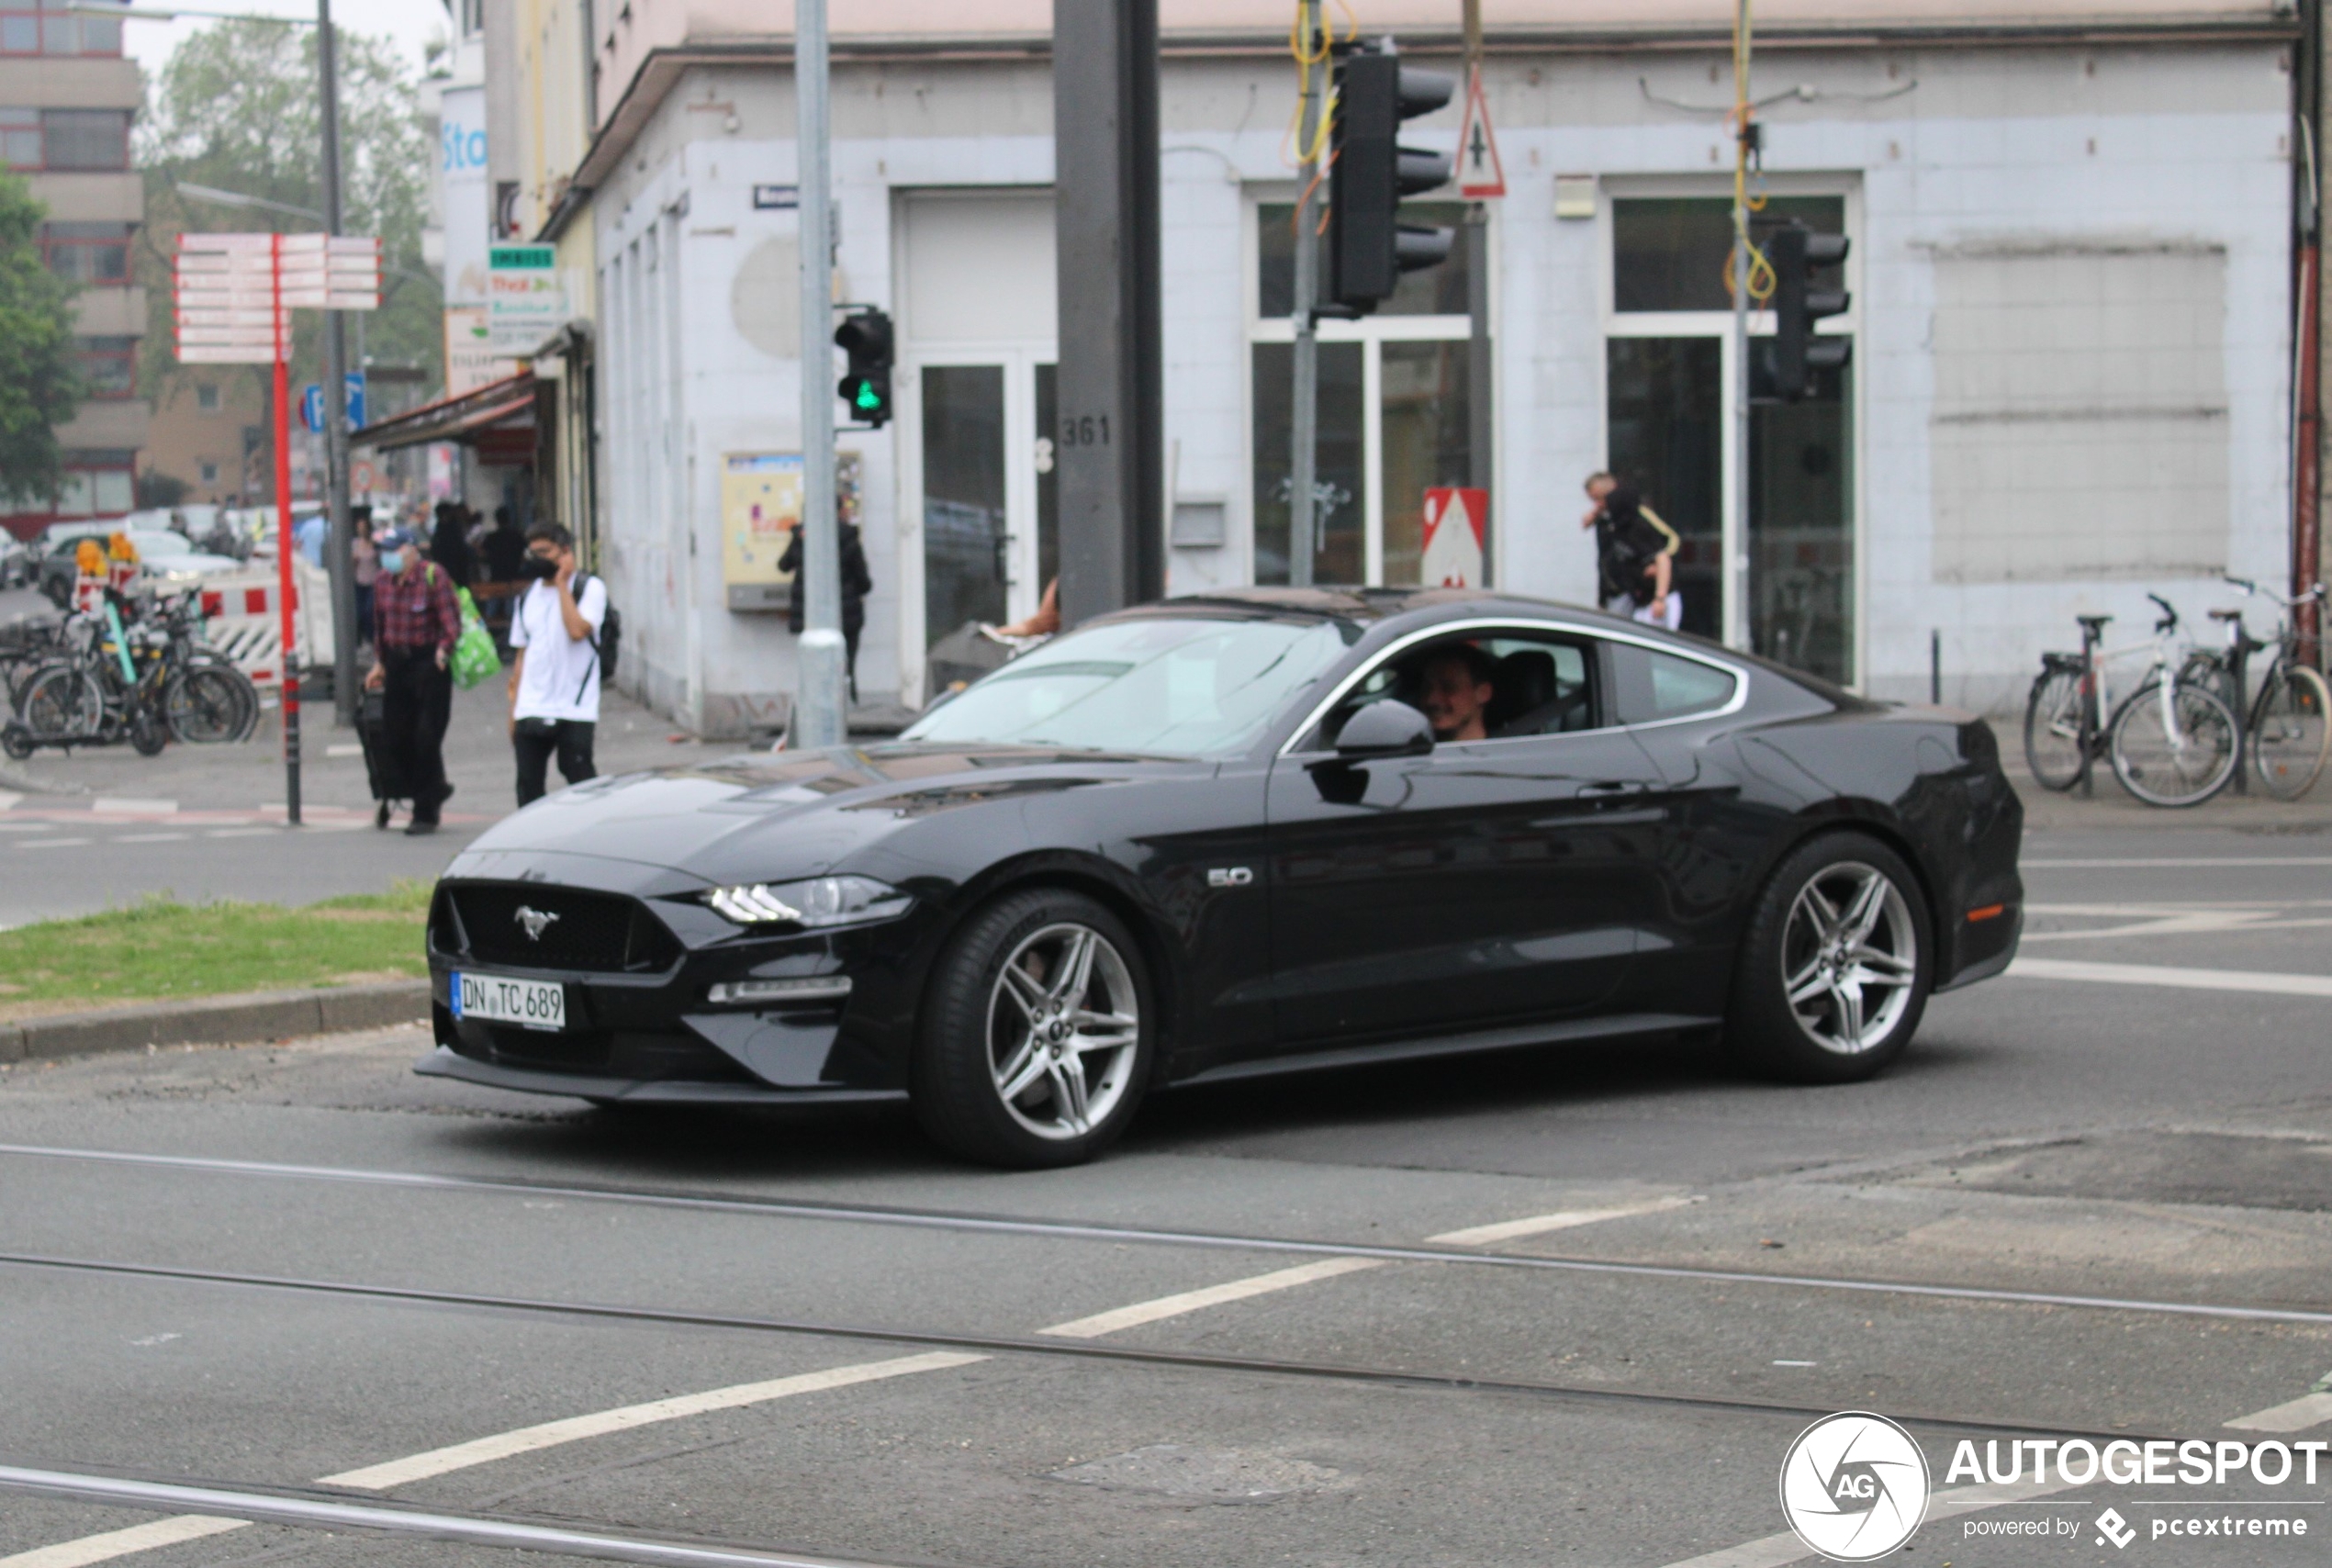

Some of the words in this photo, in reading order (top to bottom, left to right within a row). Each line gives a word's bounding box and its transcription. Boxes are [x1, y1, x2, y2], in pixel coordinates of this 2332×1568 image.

[1062, 416, 1110, 446] 361
[463, 979, 486, 1011] DN
[498, 982, 521, 1014] TC
[526, 986, 562, 1020] 689
